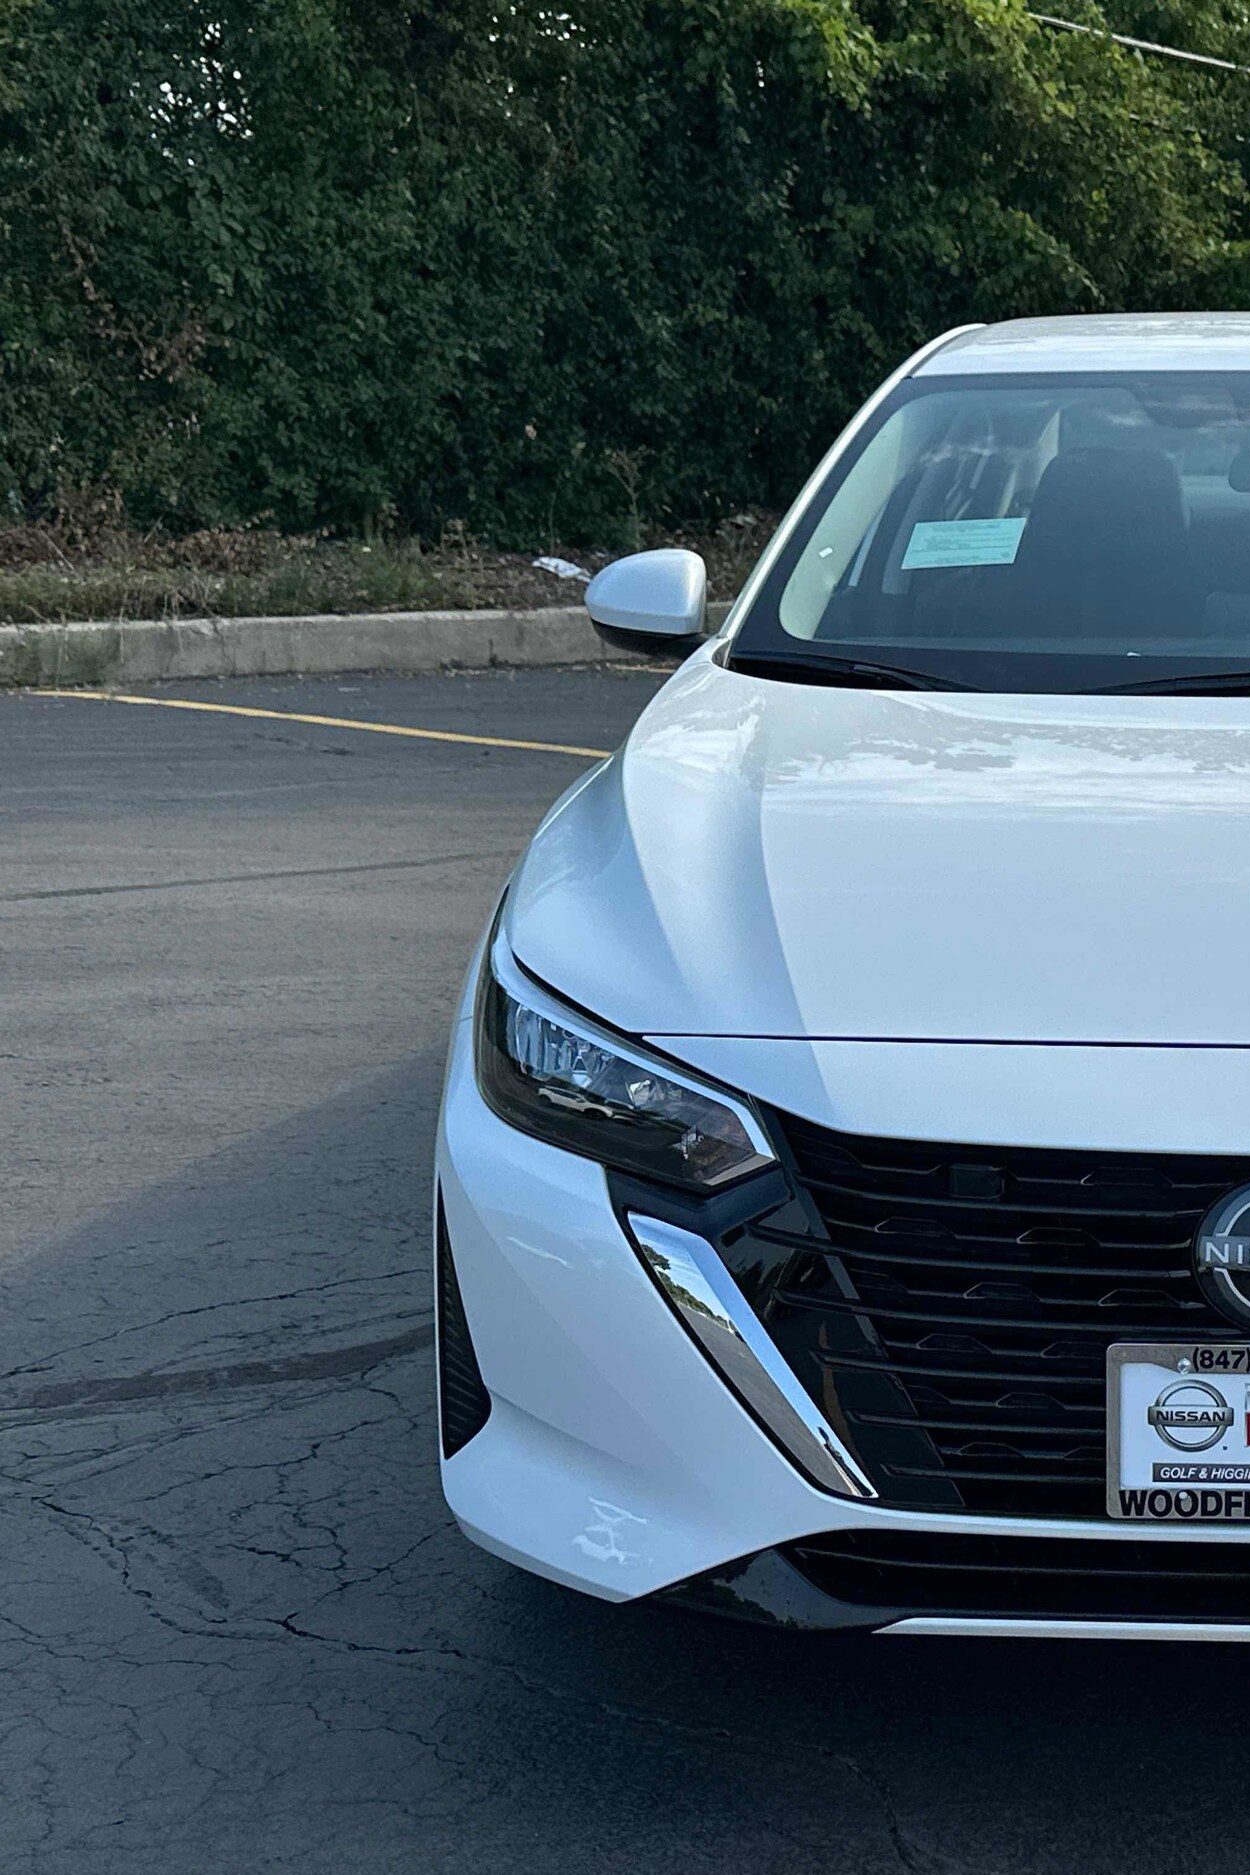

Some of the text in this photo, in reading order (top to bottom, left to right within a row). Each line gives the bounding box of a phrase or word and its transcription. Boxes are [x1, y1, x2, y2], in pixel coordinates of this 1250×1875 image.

[1156, 1410, 1226, 1423] NISSAN
[1160, 1467, 1198, 1479] GOLF
[1199, 1468, 1208, 1479] &
